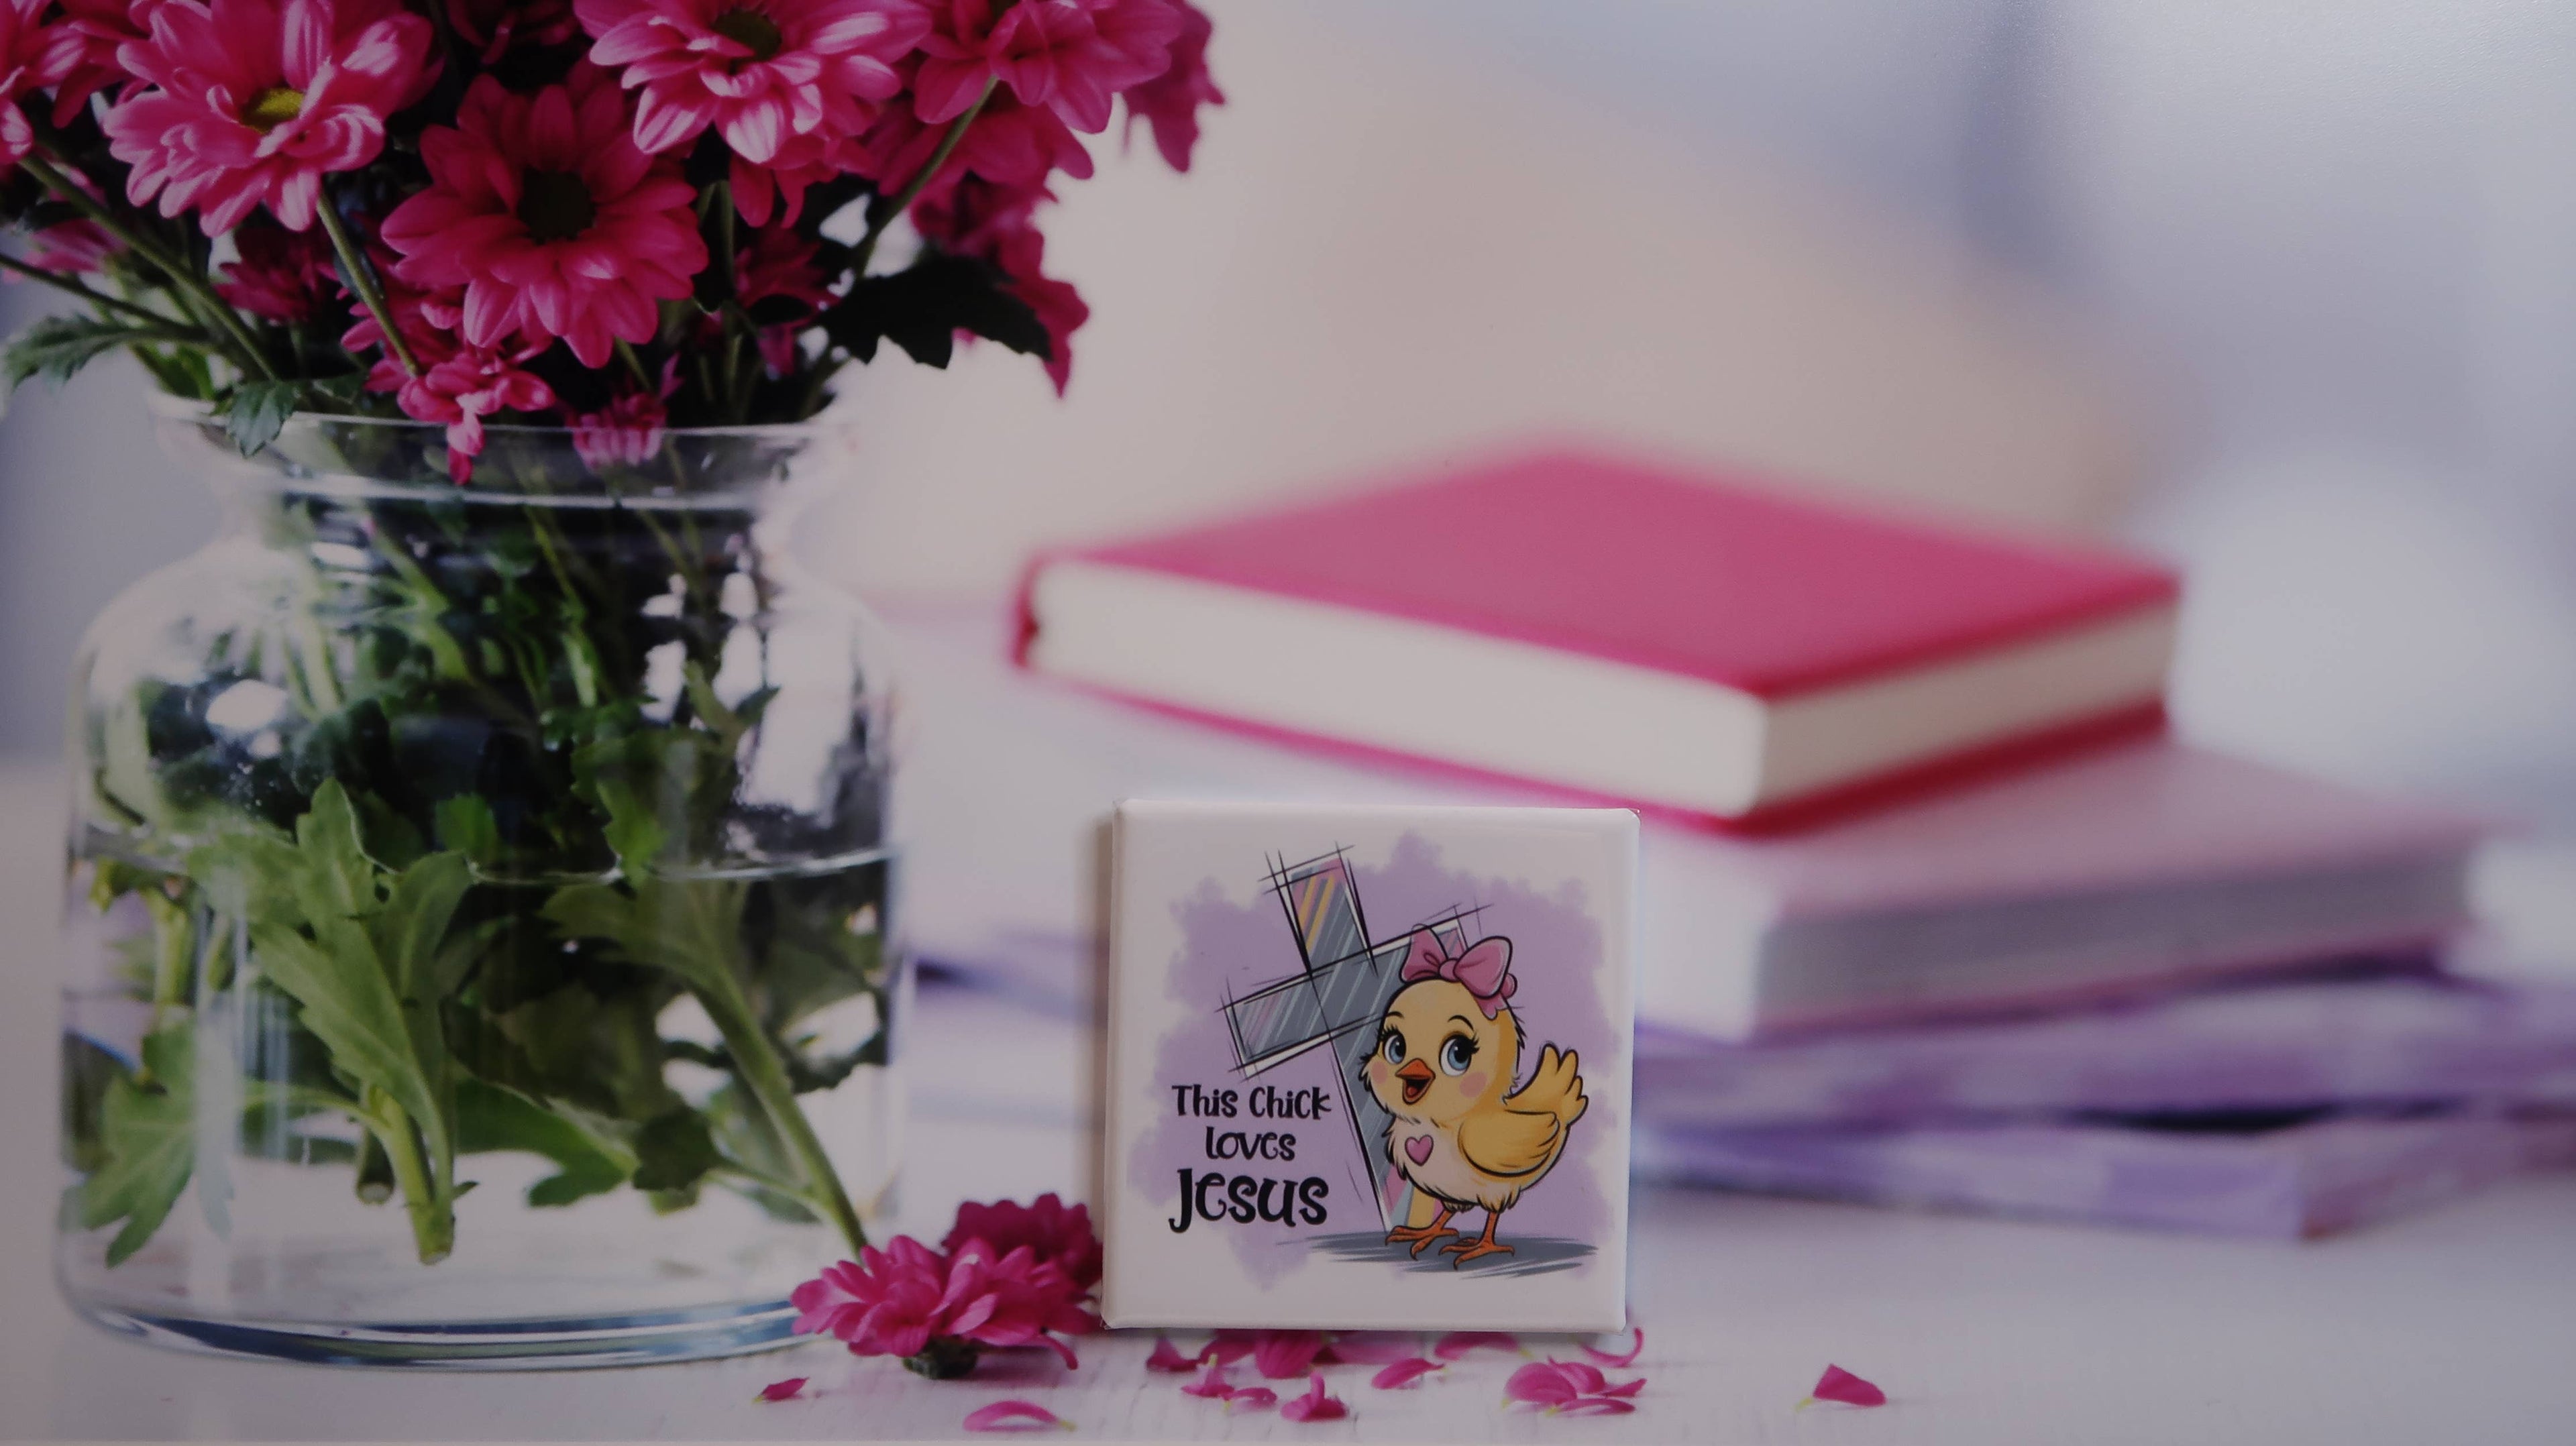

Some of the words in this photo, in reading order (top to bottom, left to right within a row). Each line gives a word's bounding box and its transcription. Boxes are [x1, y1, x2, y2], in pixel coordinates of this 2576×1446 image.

[1171, 1084, 1238, 1119] This
[1248, 1085, 1332, 1120] Chick
[1205, 1126, 1297, 1162] loves
[1168, 1168, 1329, 1234] Jesus
